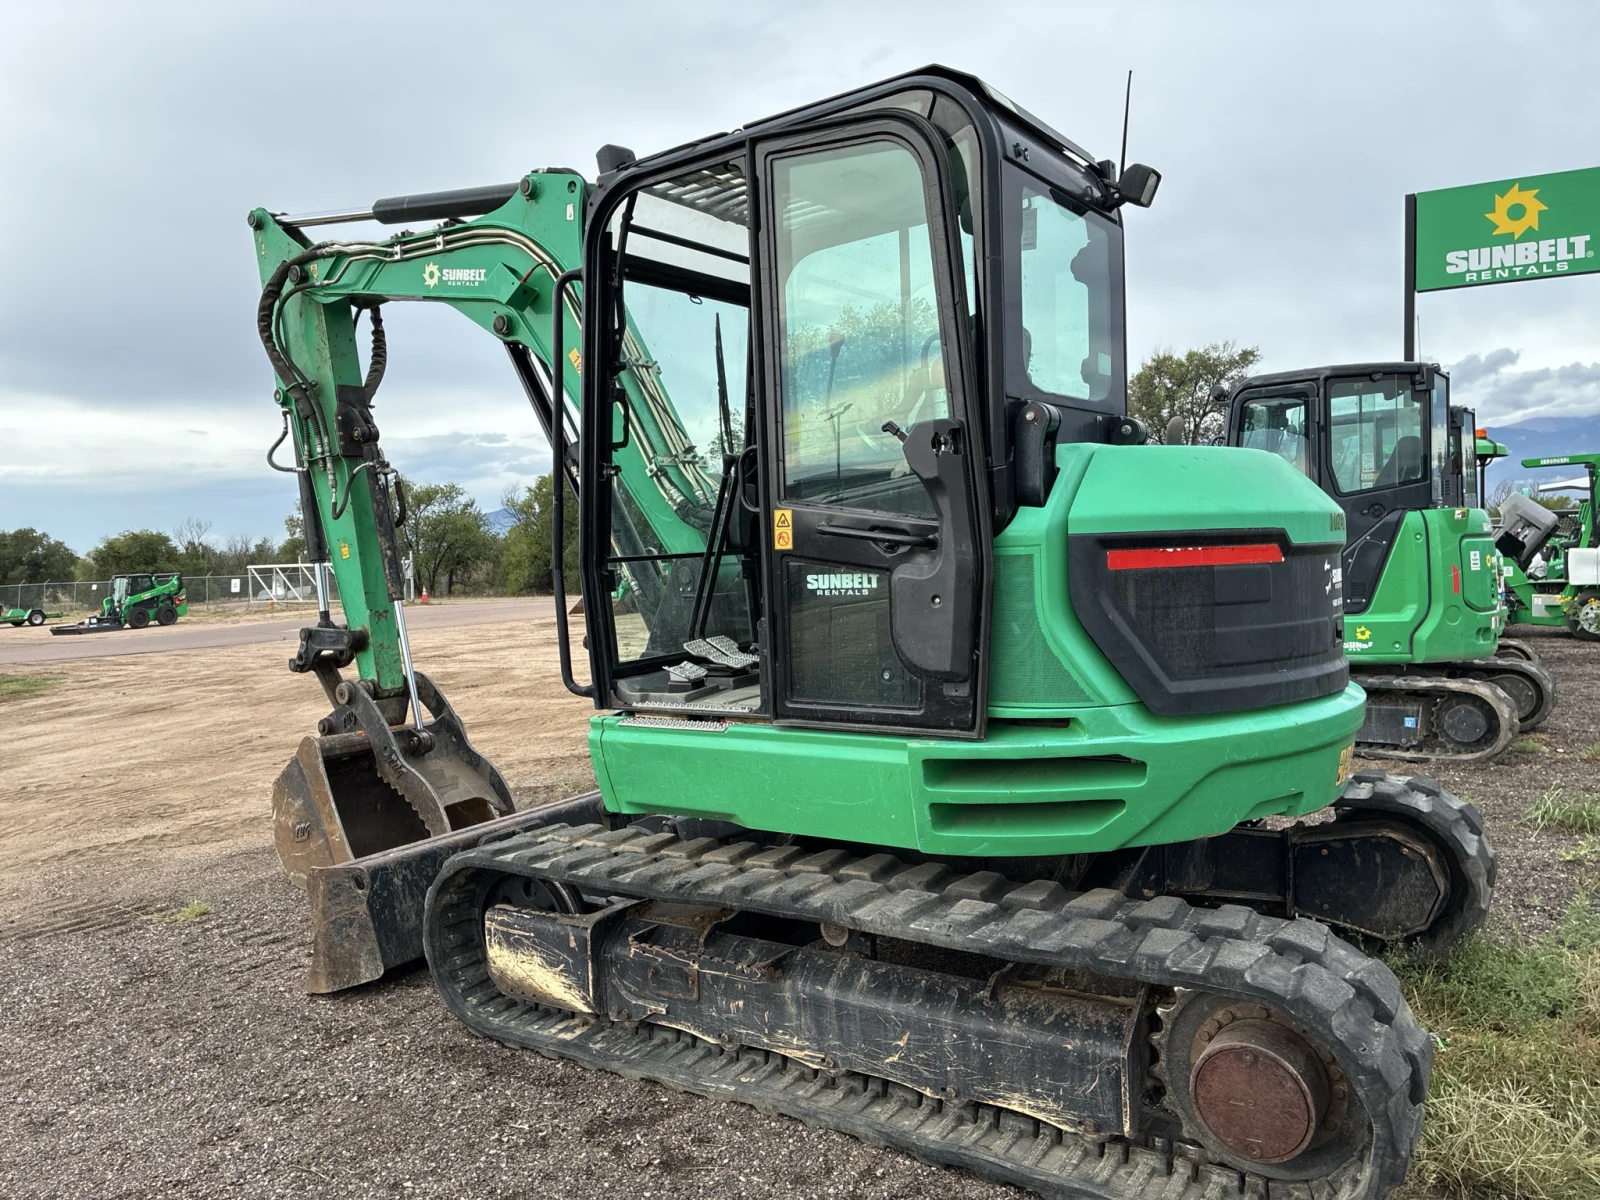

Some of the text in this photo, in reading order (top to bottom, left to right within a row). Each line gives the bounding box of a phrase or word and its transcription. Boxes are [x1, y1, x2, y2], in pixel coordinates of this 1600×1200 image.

[1446, 235, 1591, 274] SUNBELT
[442, 268, 486, 281] SUNBELT
[1466, 262, 1569, 282] RENTALS
[806, 573, 880, 590] SUNBELT
[816, 588, 869, 596] RENTALS
